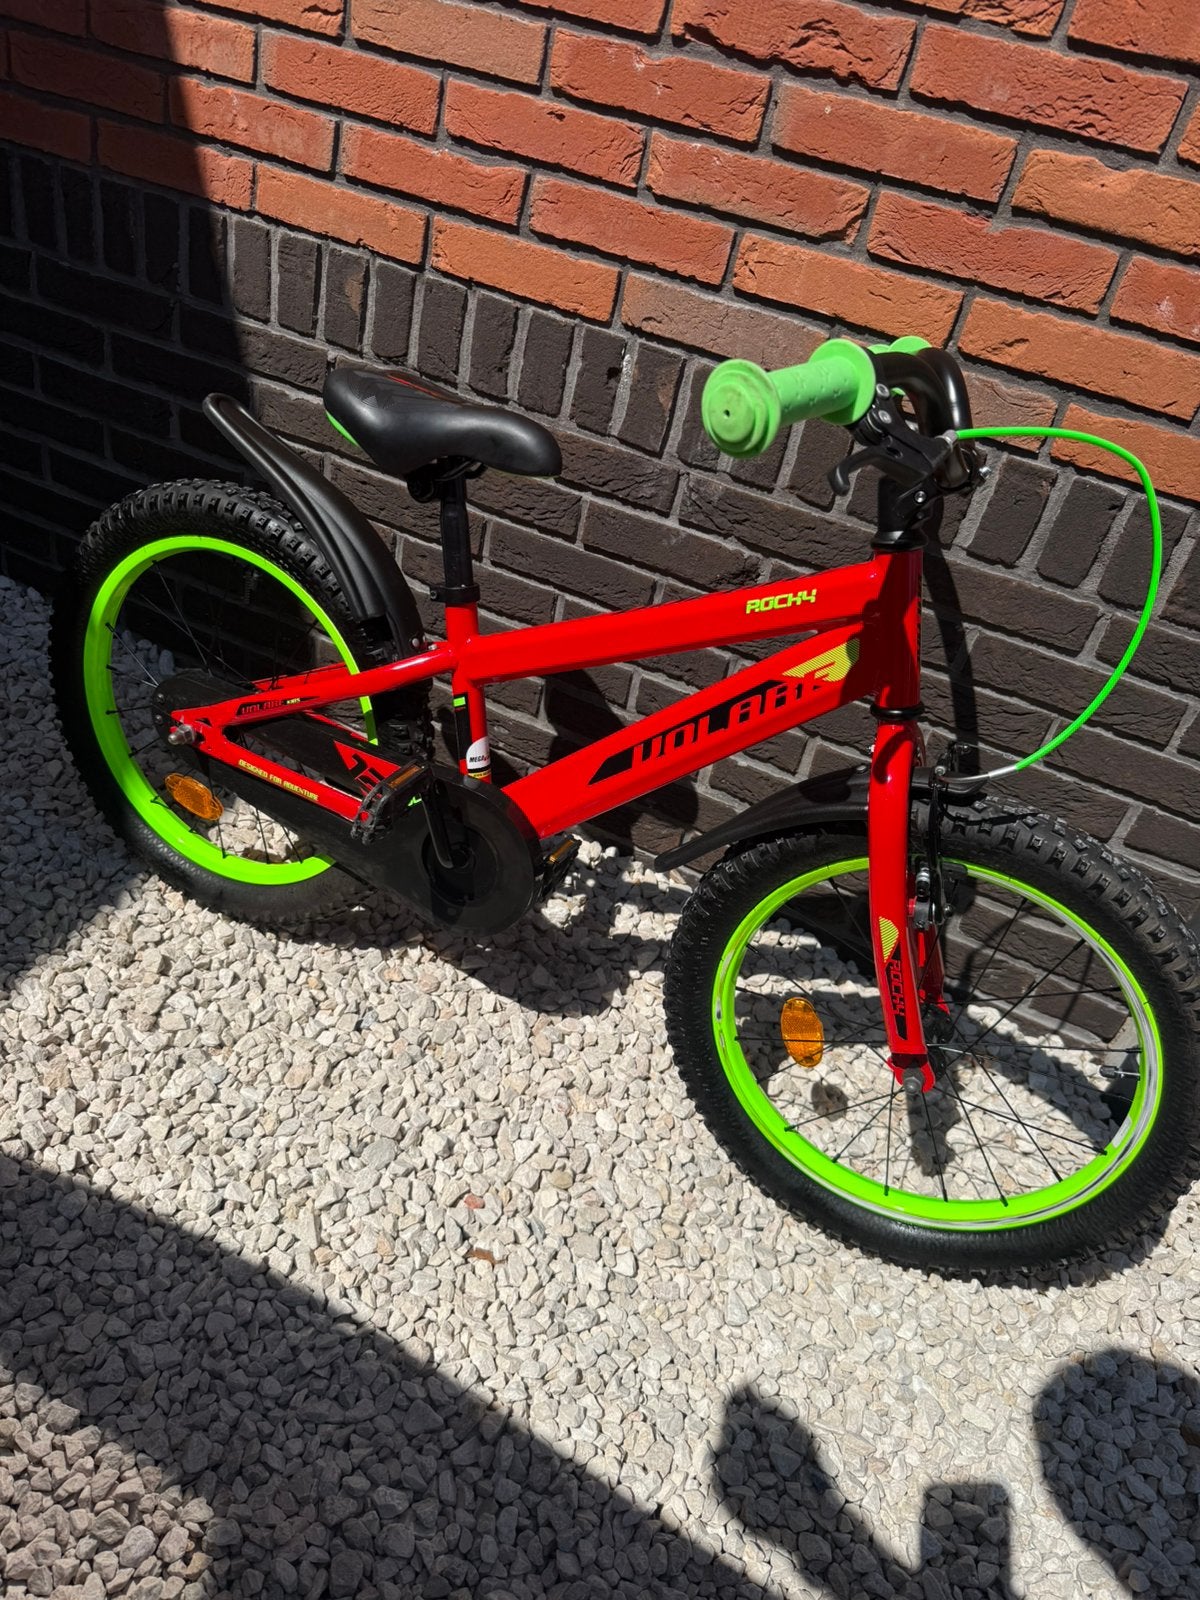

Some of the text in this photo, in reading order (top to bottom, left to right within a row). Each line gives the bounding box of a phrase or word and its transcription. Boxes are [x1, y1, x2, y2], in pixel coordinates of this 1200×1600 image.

[746, 588, 817, 614] ROCKY
[238, 758, 319, 801] DESIGNED FOR ADVENTURE
[889, 958, 905, 1016] ROCKY
